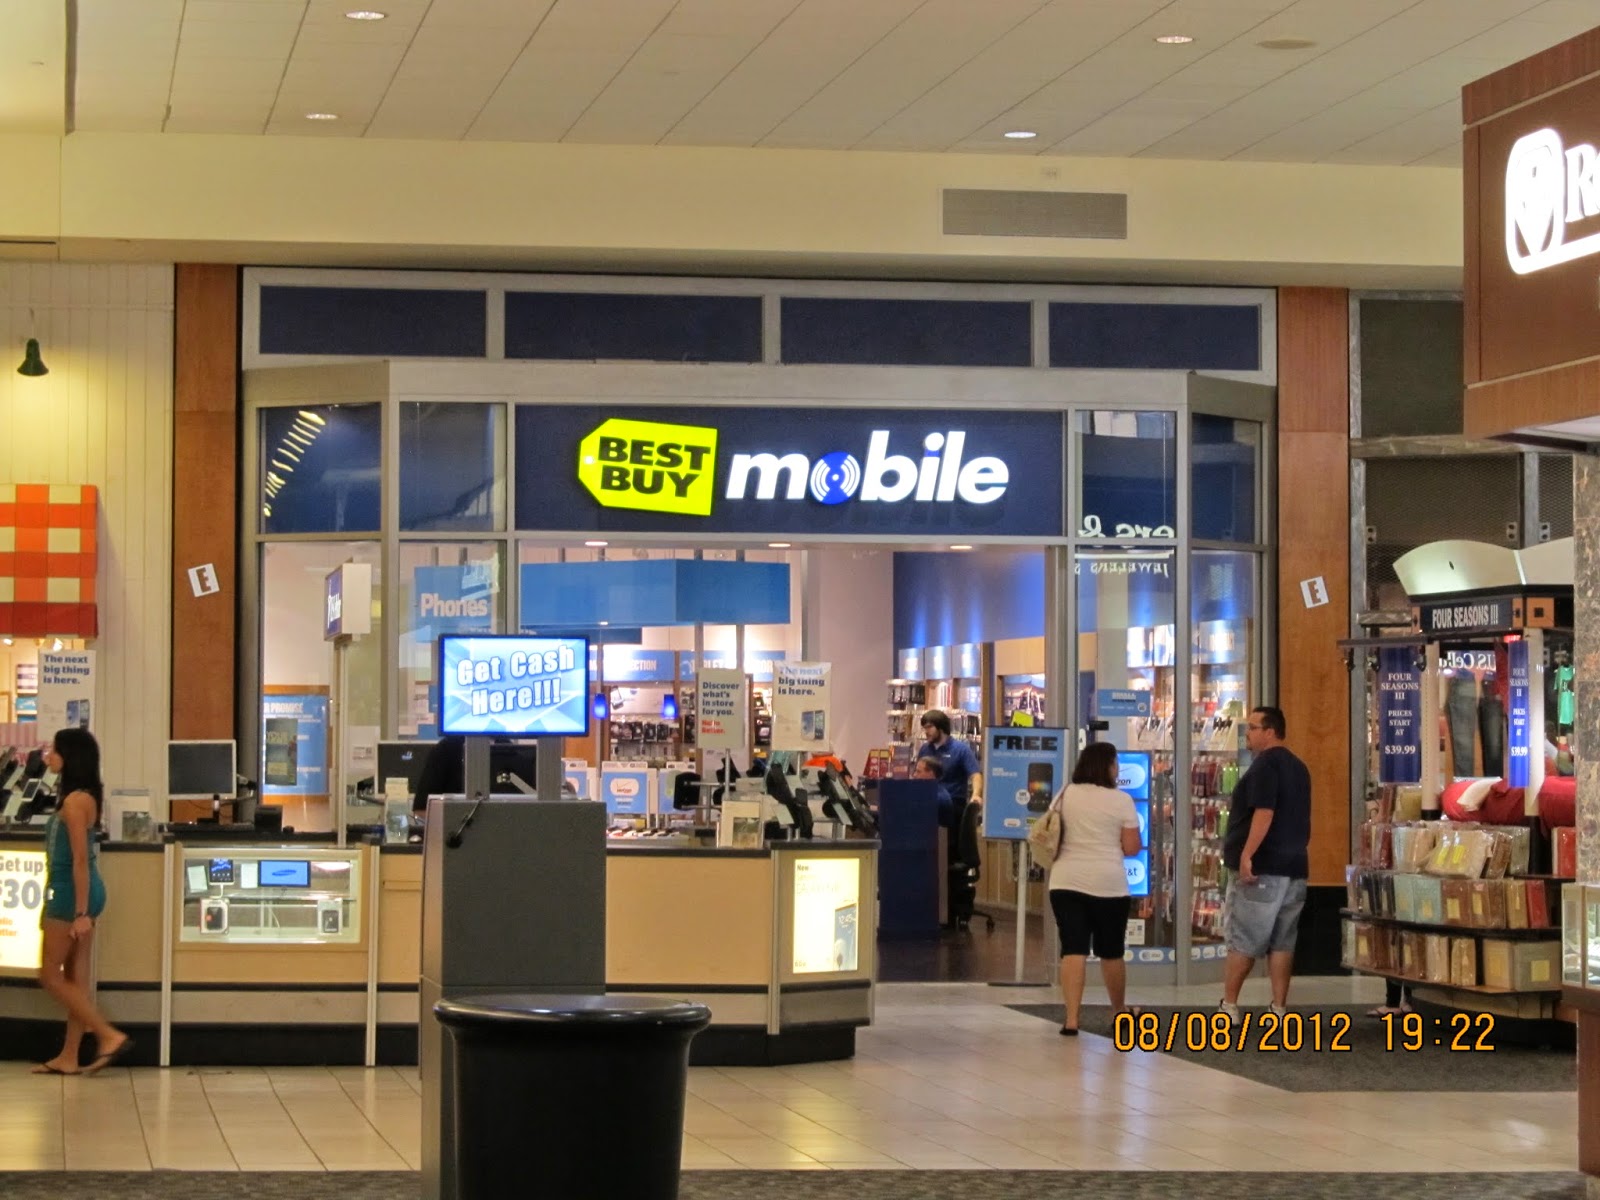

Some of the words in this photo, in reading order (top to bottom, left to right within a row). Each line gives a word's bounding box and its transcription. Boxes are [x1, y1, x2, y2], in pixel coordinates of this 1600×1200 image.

[599, 436, 711, 471] BEST
[726, 430, 1009, 504] mobile
[600, 465, 700, 498] BUY
[420, 593, 488, 617] Phones
[1432, 607, 1452, 629] FOUR
[1454, 604, 1489, 627] SEASONS
[44, 654, 63, 664] The
[64, 655, 88, 664] next
[457, 656, 502, 686] Get
[509, 645, 575, 678] Cash
[43, 666, 60, 675] big
[62, 666, 90, 676] thing
[43, 676, 52, 684] is
[54, 676, 80, 684] here.
[1388, 672, 1412, 681] FOUR
[702, 682, 739, 690] Discover
[778, 677, 795, 687] big
[797, 677, 825, 687] thing
[1381, 682, 1419, 691] SEASONS
[1510, 678, 1528, 686] SEASONS
[471, 677, 561, 716] Here!!!
[702, 690, 730, 698] what's
[778, 687, 787, 696] is
[789, 687, 815, 696] here.
[1395, 692, 1405, 700] III
[702, 699, 711, 707] in
[712, 700, 734, 708] store
[702, 708, 716, 716] for
[717, 709, 734, 717] you.
[1388, 709, 1412, 717] PRICES
[1395, 728, 1405, 736] AT
[993, 735, 1058, 751] FREE
[1385, 744, 1416, 755] $39.99
[1511, 746, 1528, 757] $39.99
[23, 859, 43, 876] up
[0, 878, 41, 910] 30
